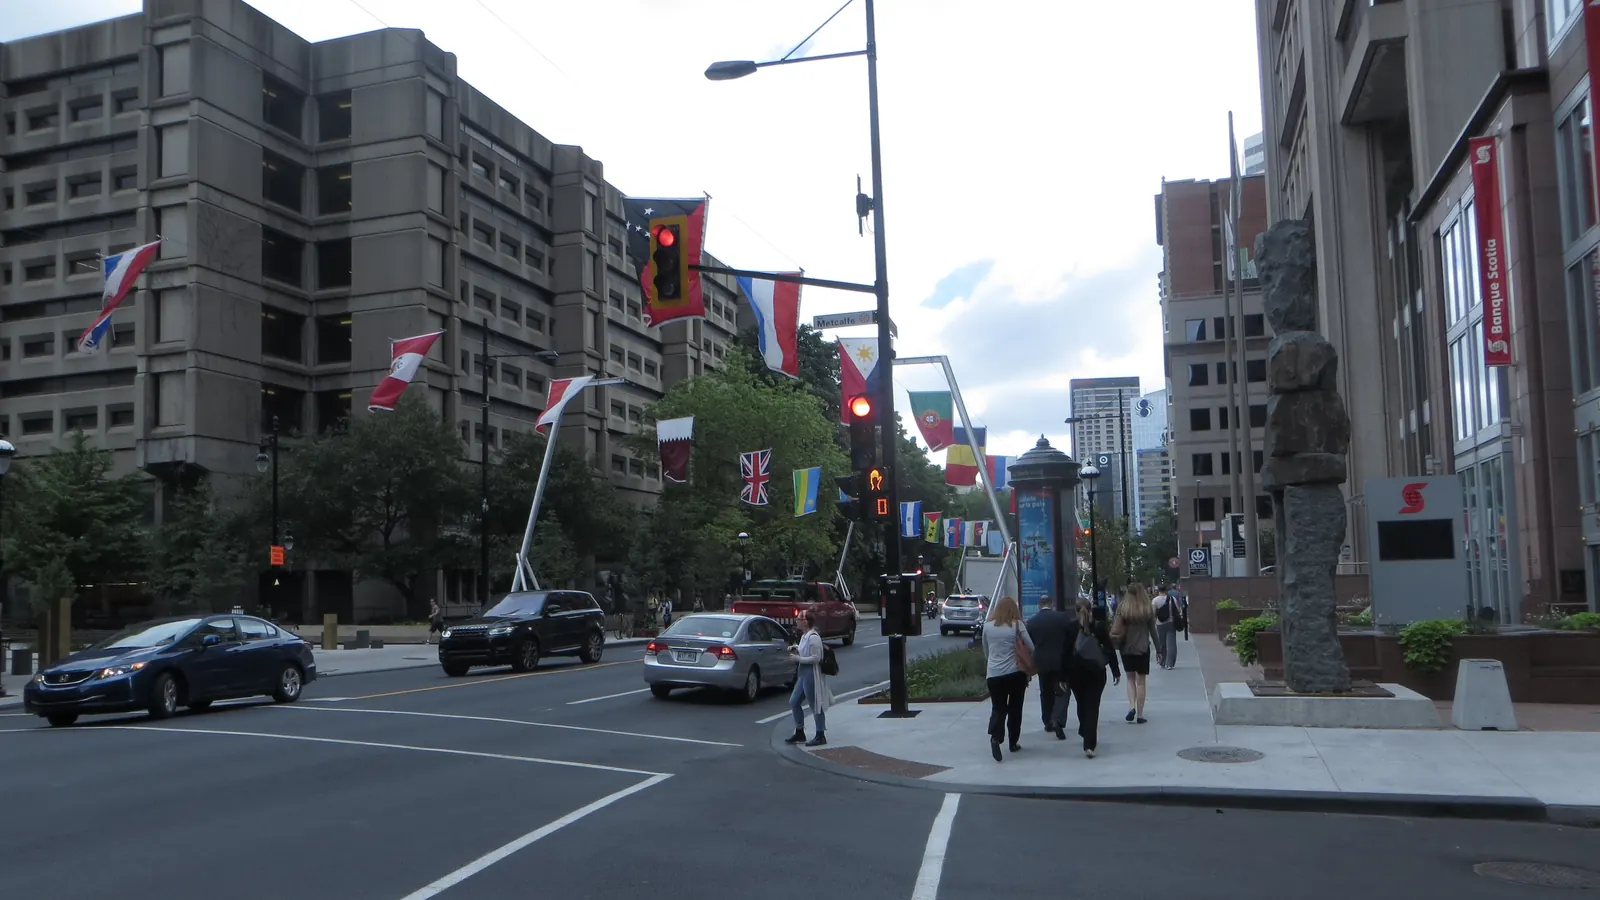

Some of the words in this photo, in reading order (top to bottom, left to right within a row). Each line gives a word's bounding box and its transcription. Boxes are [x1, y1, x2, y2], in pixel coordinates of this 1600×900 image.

[1485, 239, 1499, 279] Scotia
[817, 317, 856, 328] Metcalfe
[1490, 282, 1503, 334] Banque
